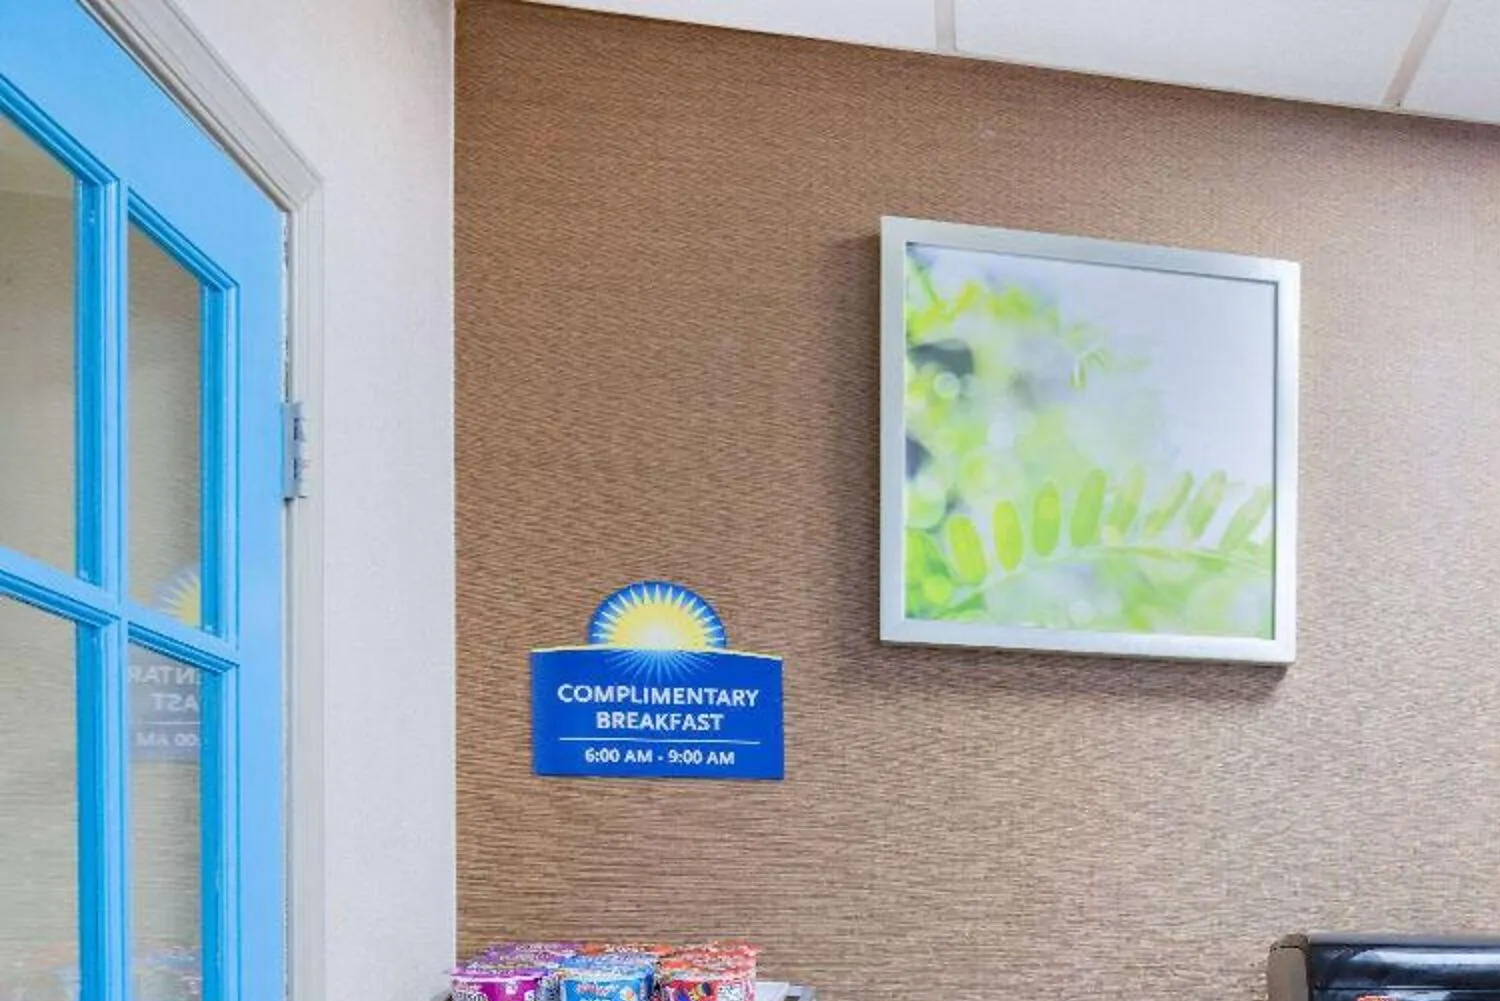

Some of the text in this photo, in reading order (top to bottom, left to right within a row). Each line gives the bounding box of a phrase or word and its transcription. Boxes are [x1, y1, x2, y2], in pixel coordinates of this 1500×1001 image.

[557, 684, 759, 707] COMPLIMENTARY
[596, 712, 724, 731] BREAKFAST
[585, 748, 620, 763] 6:00
[624, 749, 653, 763] AM
[669, 750, 702, 764] 9:00
[706, 751, 735, 765] AM
